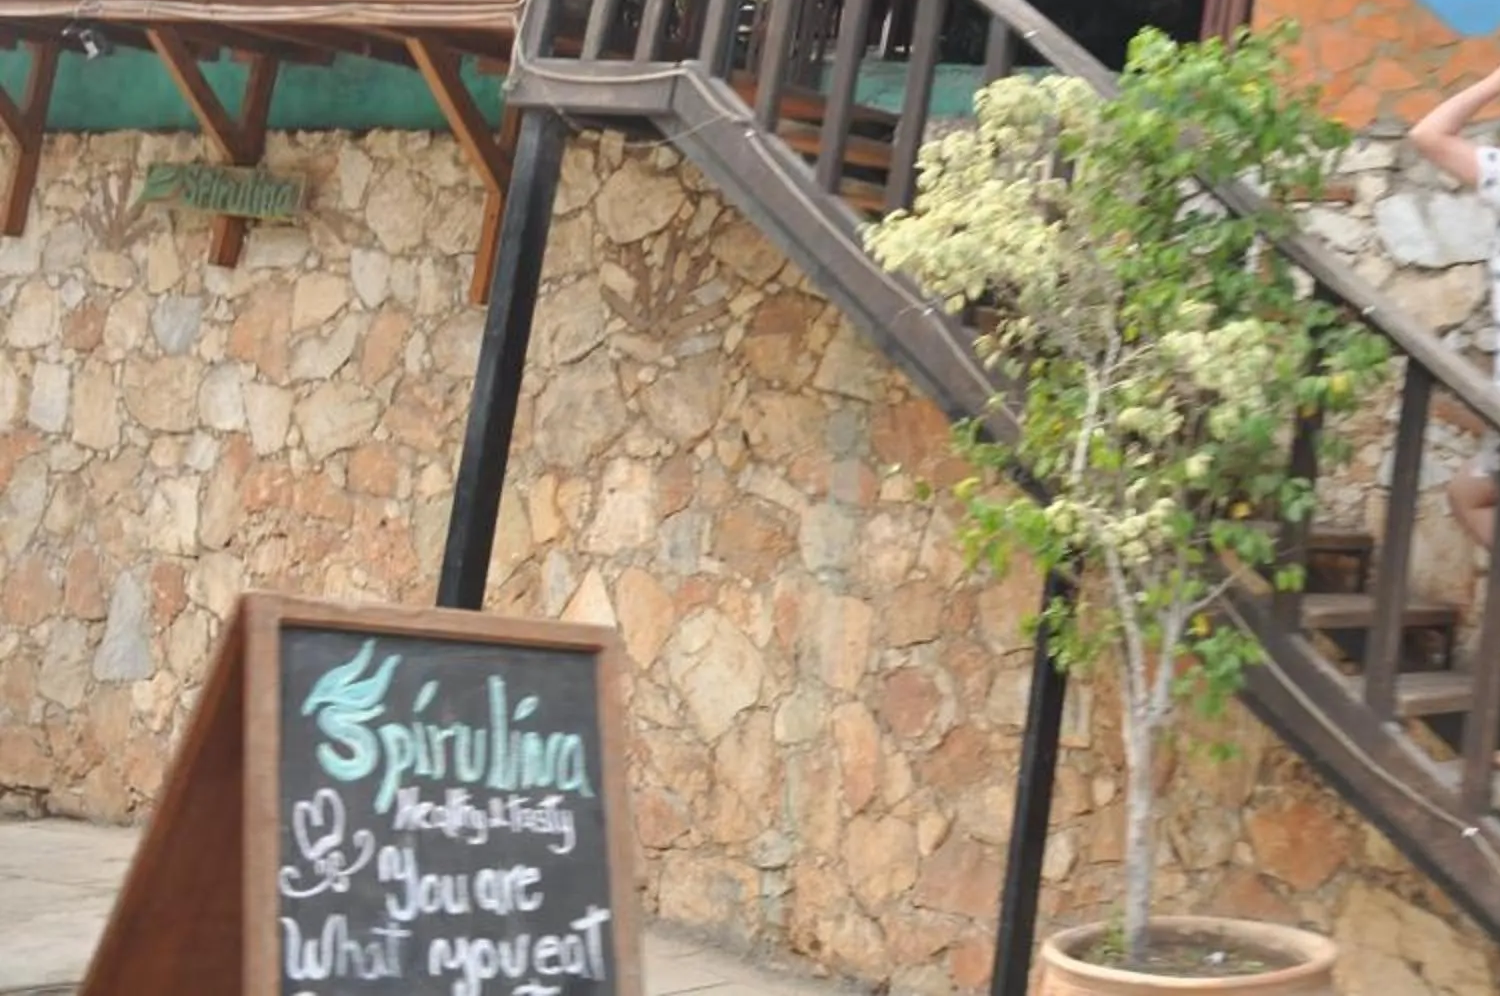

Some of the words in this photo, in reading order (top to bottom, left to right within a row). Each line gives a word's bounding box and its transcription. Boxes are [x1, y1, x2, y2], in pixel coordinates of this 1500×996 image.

[314, 675, 595, 814] Spirulina
[473, 865, 545, 915] are
[281, 913, 413, 981] What
[532, 905, 612, 981] eat
